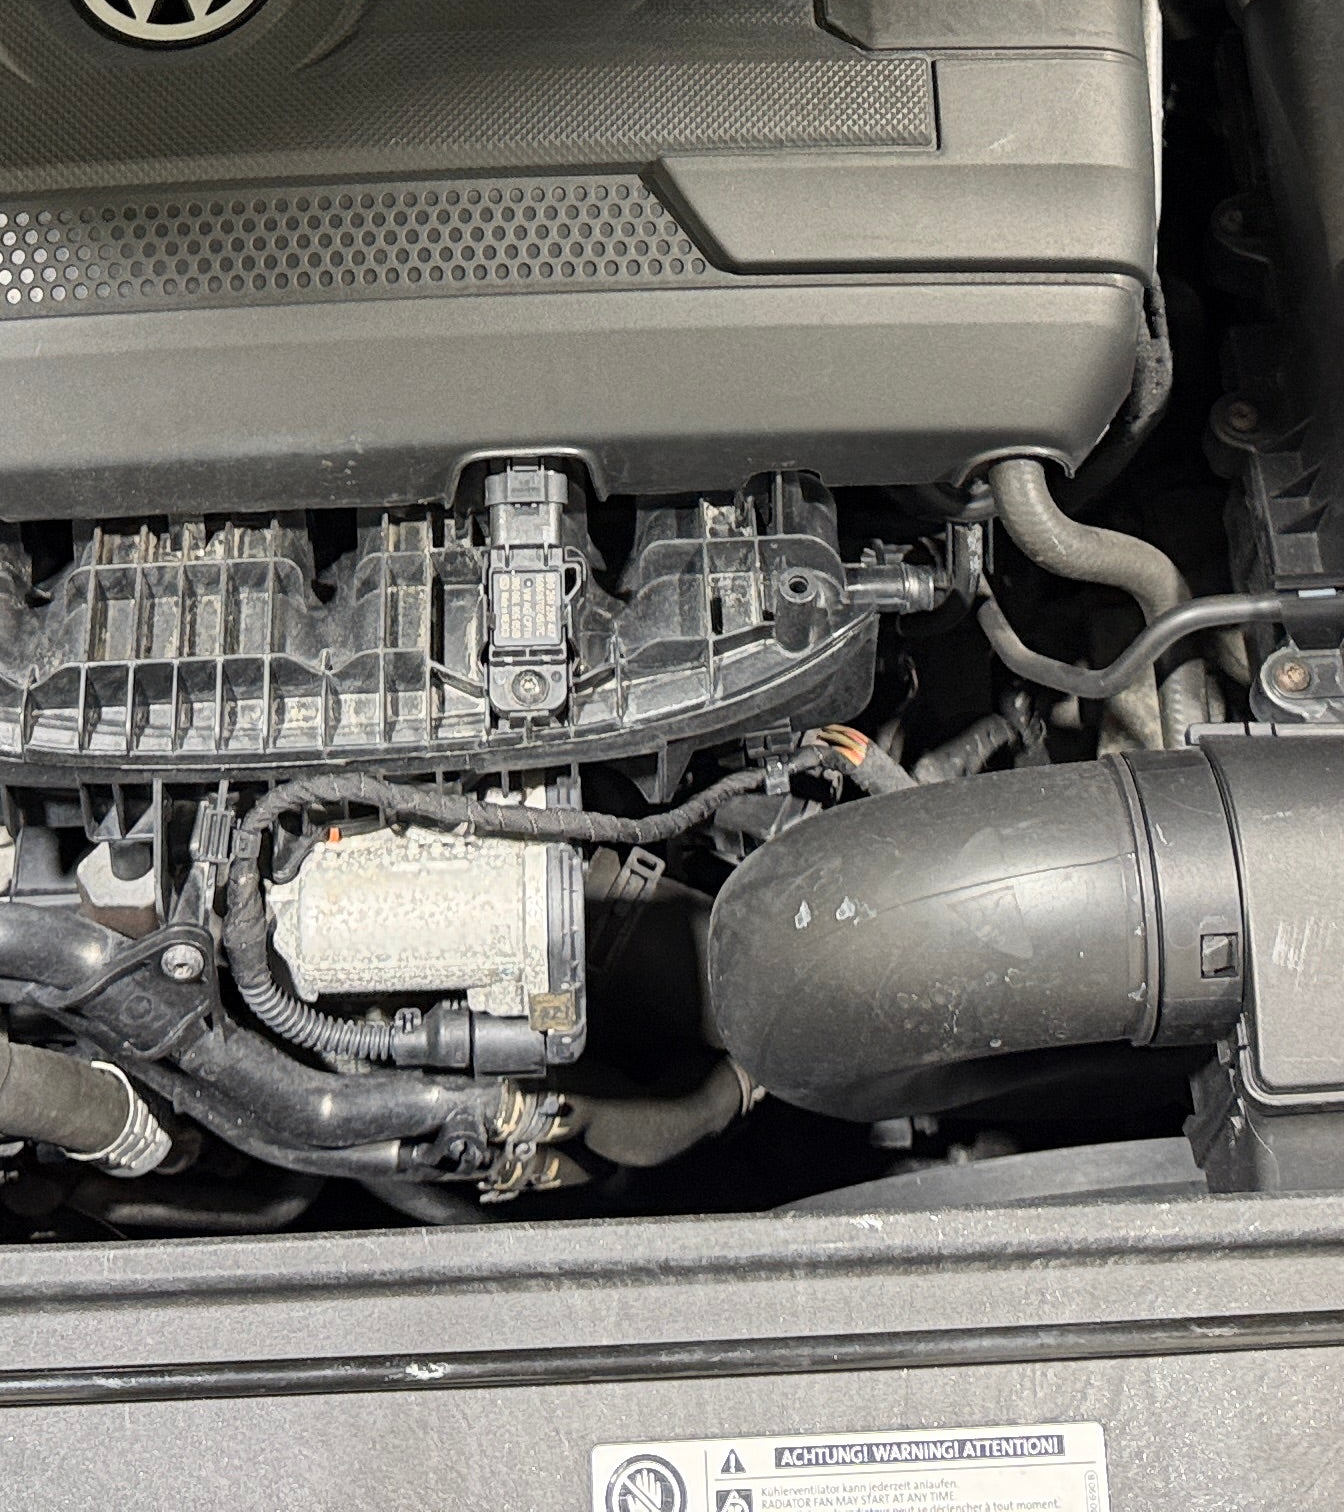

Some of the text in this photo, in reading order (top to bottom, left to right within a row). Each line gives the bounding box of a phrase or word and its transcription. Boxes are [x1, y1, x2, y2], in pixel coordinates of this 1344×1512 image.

[781, 1436, 1058, 1467] ACHTUNG! WARNING! ATTENTION!
[843, 1483, 866, 1493] kann
[869, 1481, 911, 1496] jederzeit
[761, 1498, 811, 1509] RADIATOR
[814, 1496, 832, 1506] FAN
[836, 1495, 858, 1505] MAY
[862, 1493, 889, 1504] START
[893, 1493, 904, 1503] AT
[907, 1493, 927, 1502] ANY
[993, 1501, 1014, 1511] tout
